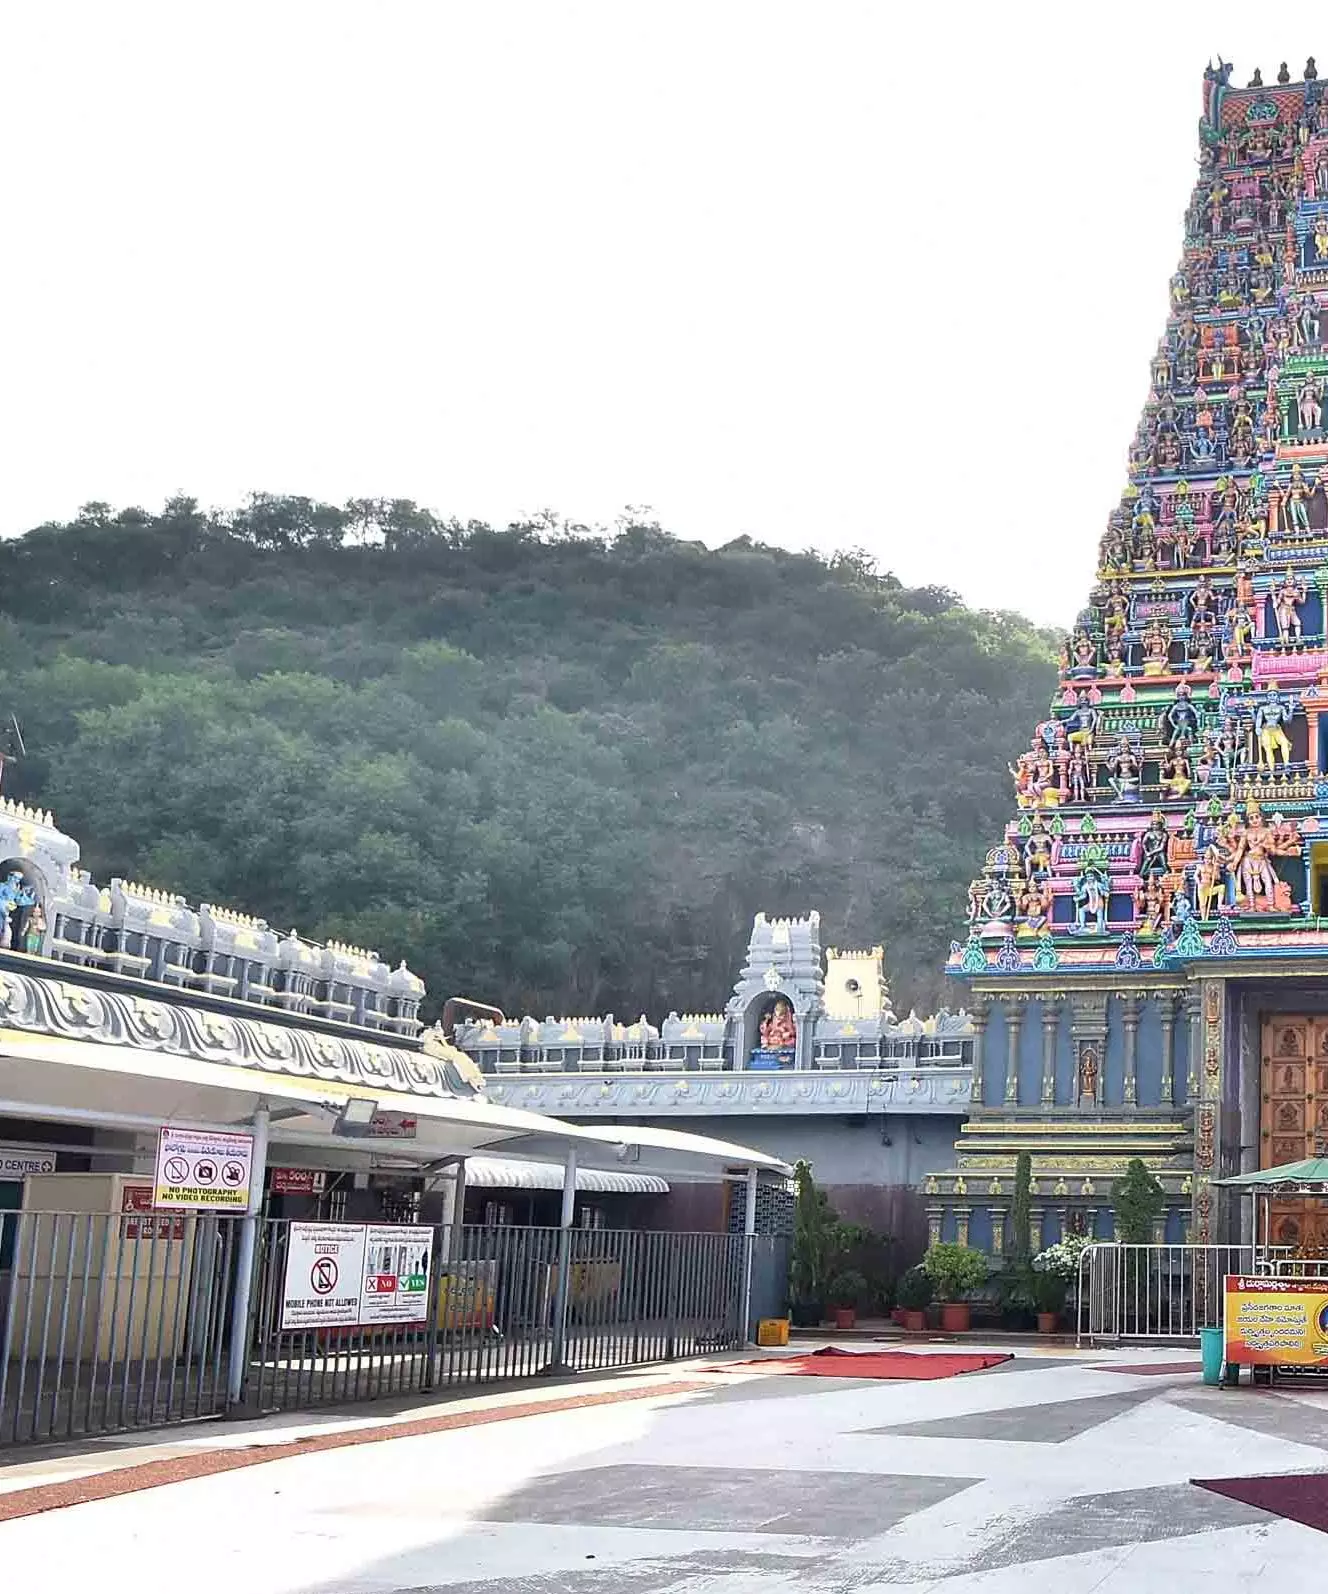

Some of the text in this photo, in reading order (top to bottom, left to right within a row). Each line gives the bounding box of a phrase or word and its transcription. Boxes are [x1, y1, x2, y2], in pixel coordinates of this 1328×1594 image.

[5, 1160, 41, 1172] CENTRE
[182, 1187, 238, 1196] PHOTOGRAPHY
[175, 1193, 199, 1201] VIDEO
[201, 1195, 242, 1203] RECORDING
[315, 1244, 338, 1254] NOTICE
[380, 1279, 392, 1288] NO
[411, 1279, 425, 1288] YES
[285, 1299, 305, 1309] MOBILE
[306, 1298, 323, 1308] PHONE
[324, 1298, 335, 1307] NOT
[335, 1298, 357, 1307] ALLOWED
